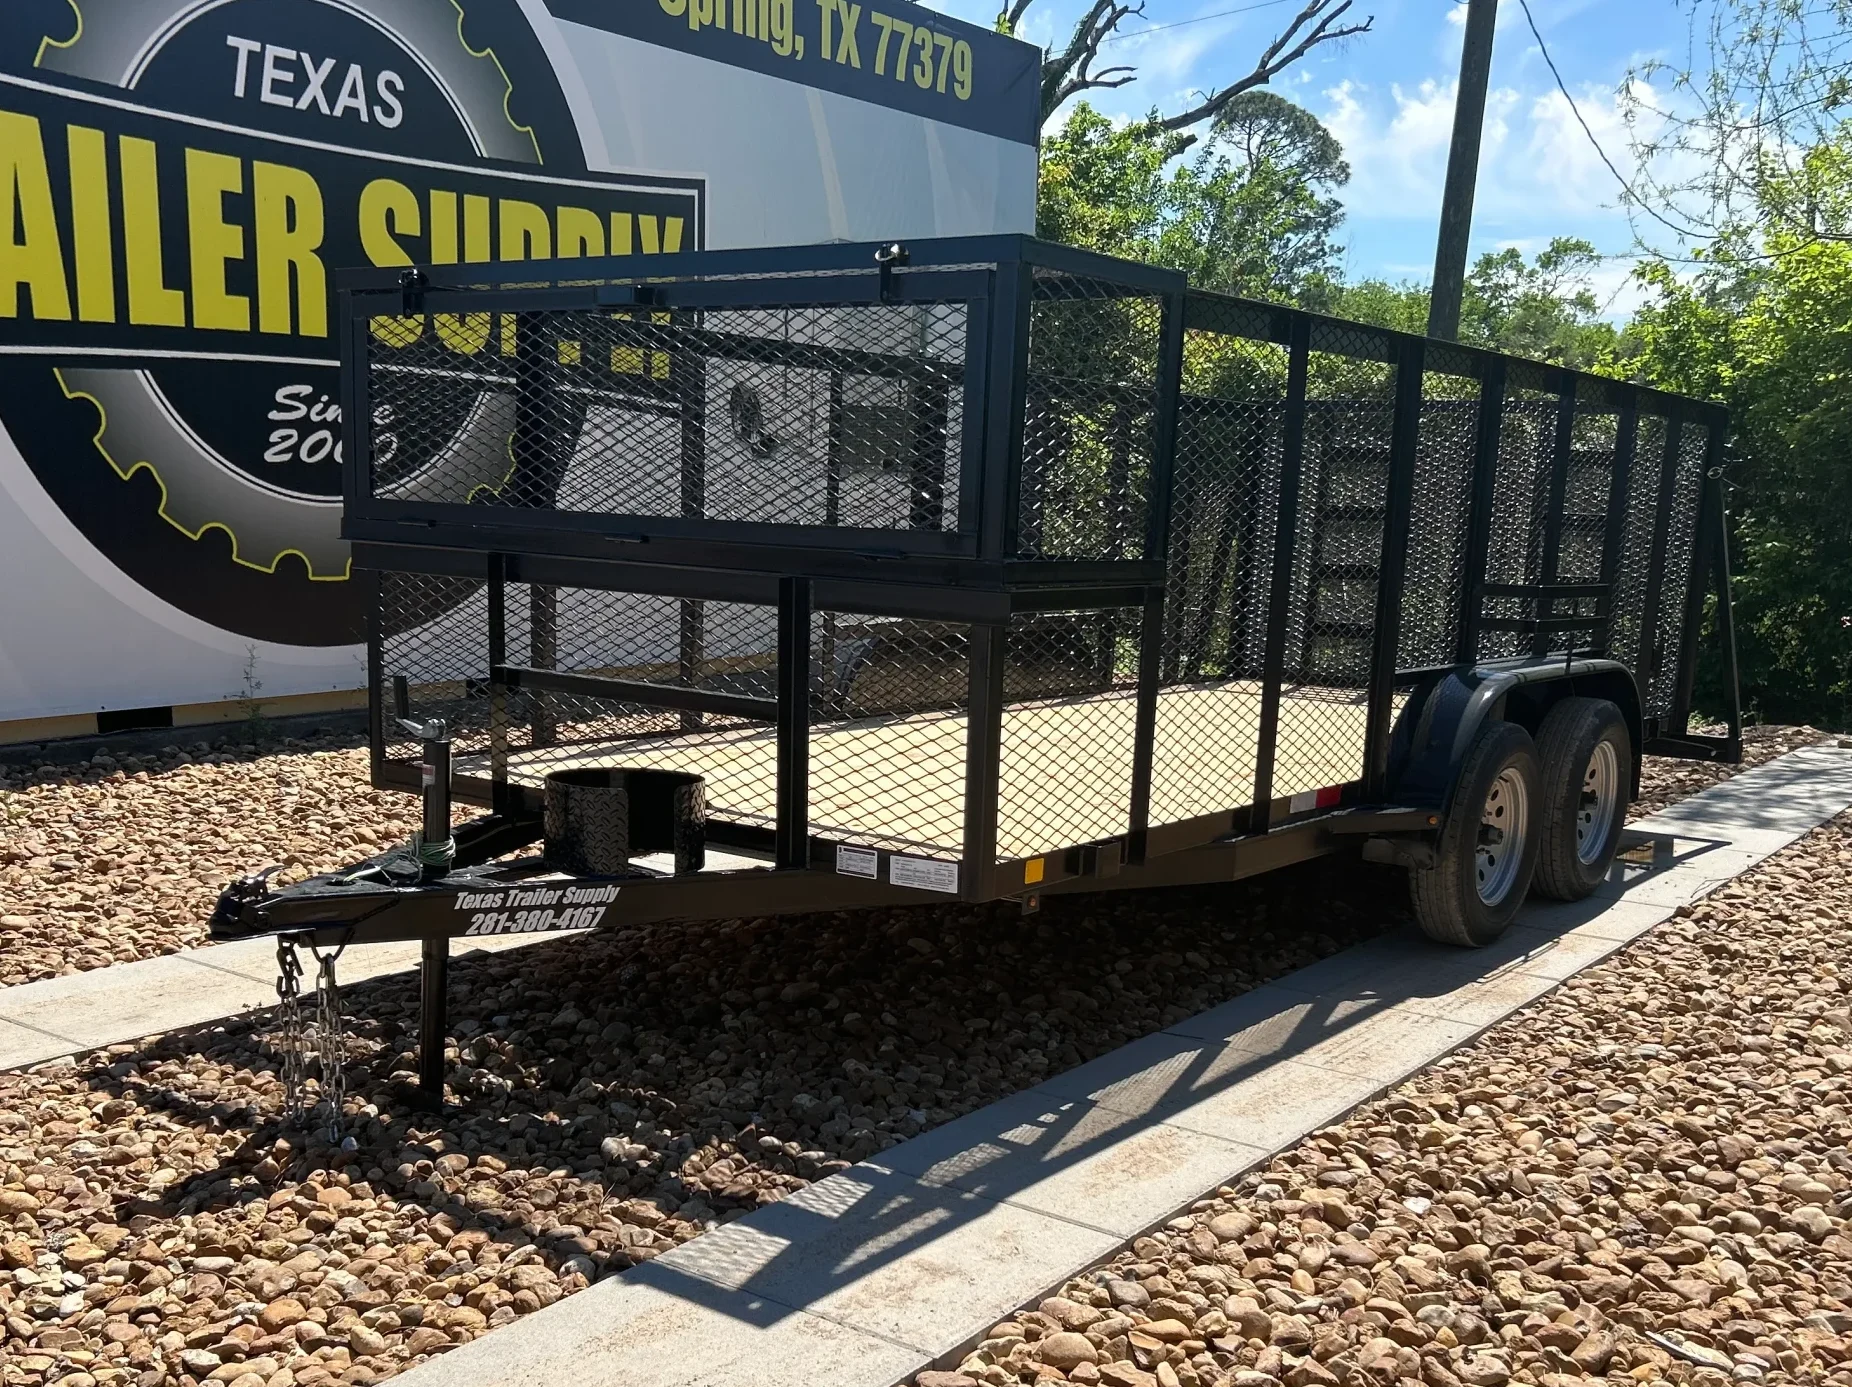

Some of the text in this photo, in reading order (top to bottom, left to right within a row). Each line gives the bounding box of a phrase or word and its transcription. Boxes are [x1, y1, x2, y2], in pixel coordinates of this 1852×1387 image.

[816, 0, 861, 69] TX
[871, 11, 972, 100] 77379
[226, 36, 405, 129] TEXAS
[267, 384, 395, 425] Sine
[454, 884, 621, 910] Texas Trailer Supply
[465, 906, 607, 936] 281-380-4167
